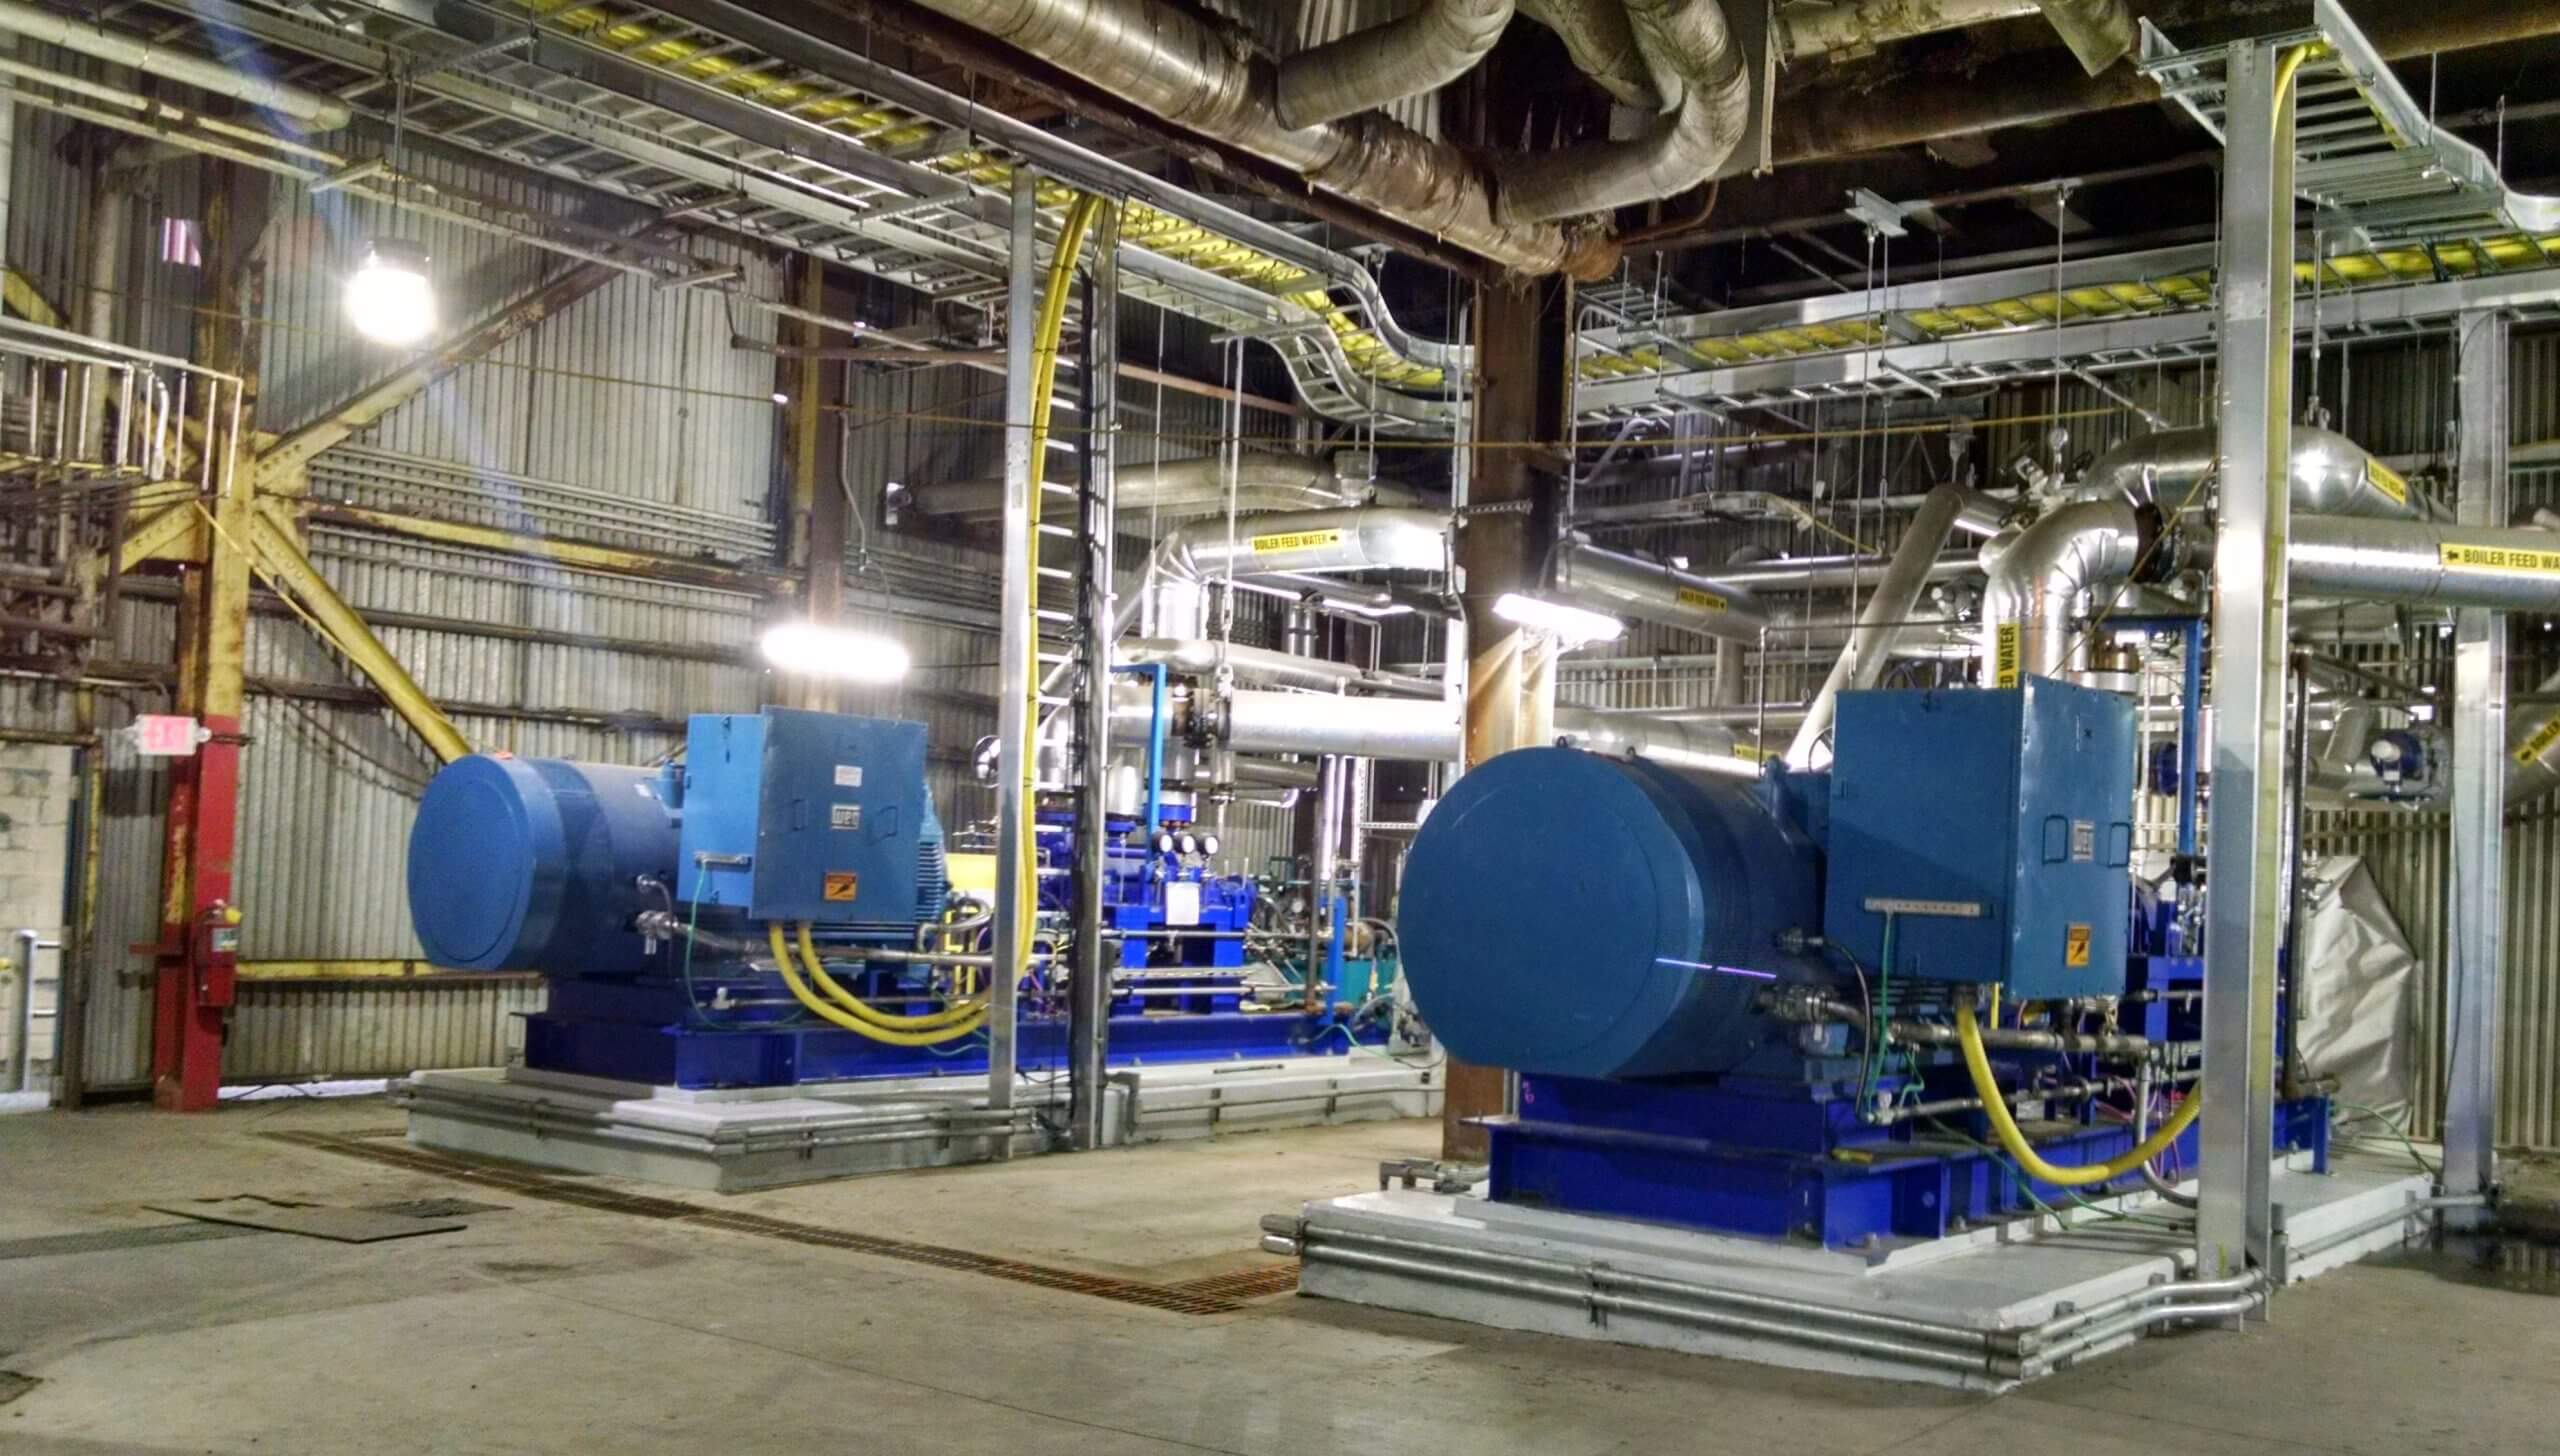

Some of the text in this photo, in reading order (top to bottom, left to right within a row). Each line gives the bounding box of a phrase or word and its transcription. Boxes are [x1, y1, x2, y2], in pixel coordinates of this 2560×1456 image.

[1253, 533, 1327, 551] BOILER FEED WATER
[2463, 549, 2505, 566] BOILER
[2508, 552, 2537, 568] FEED
[2000, 626, 2014, 672] WATER
